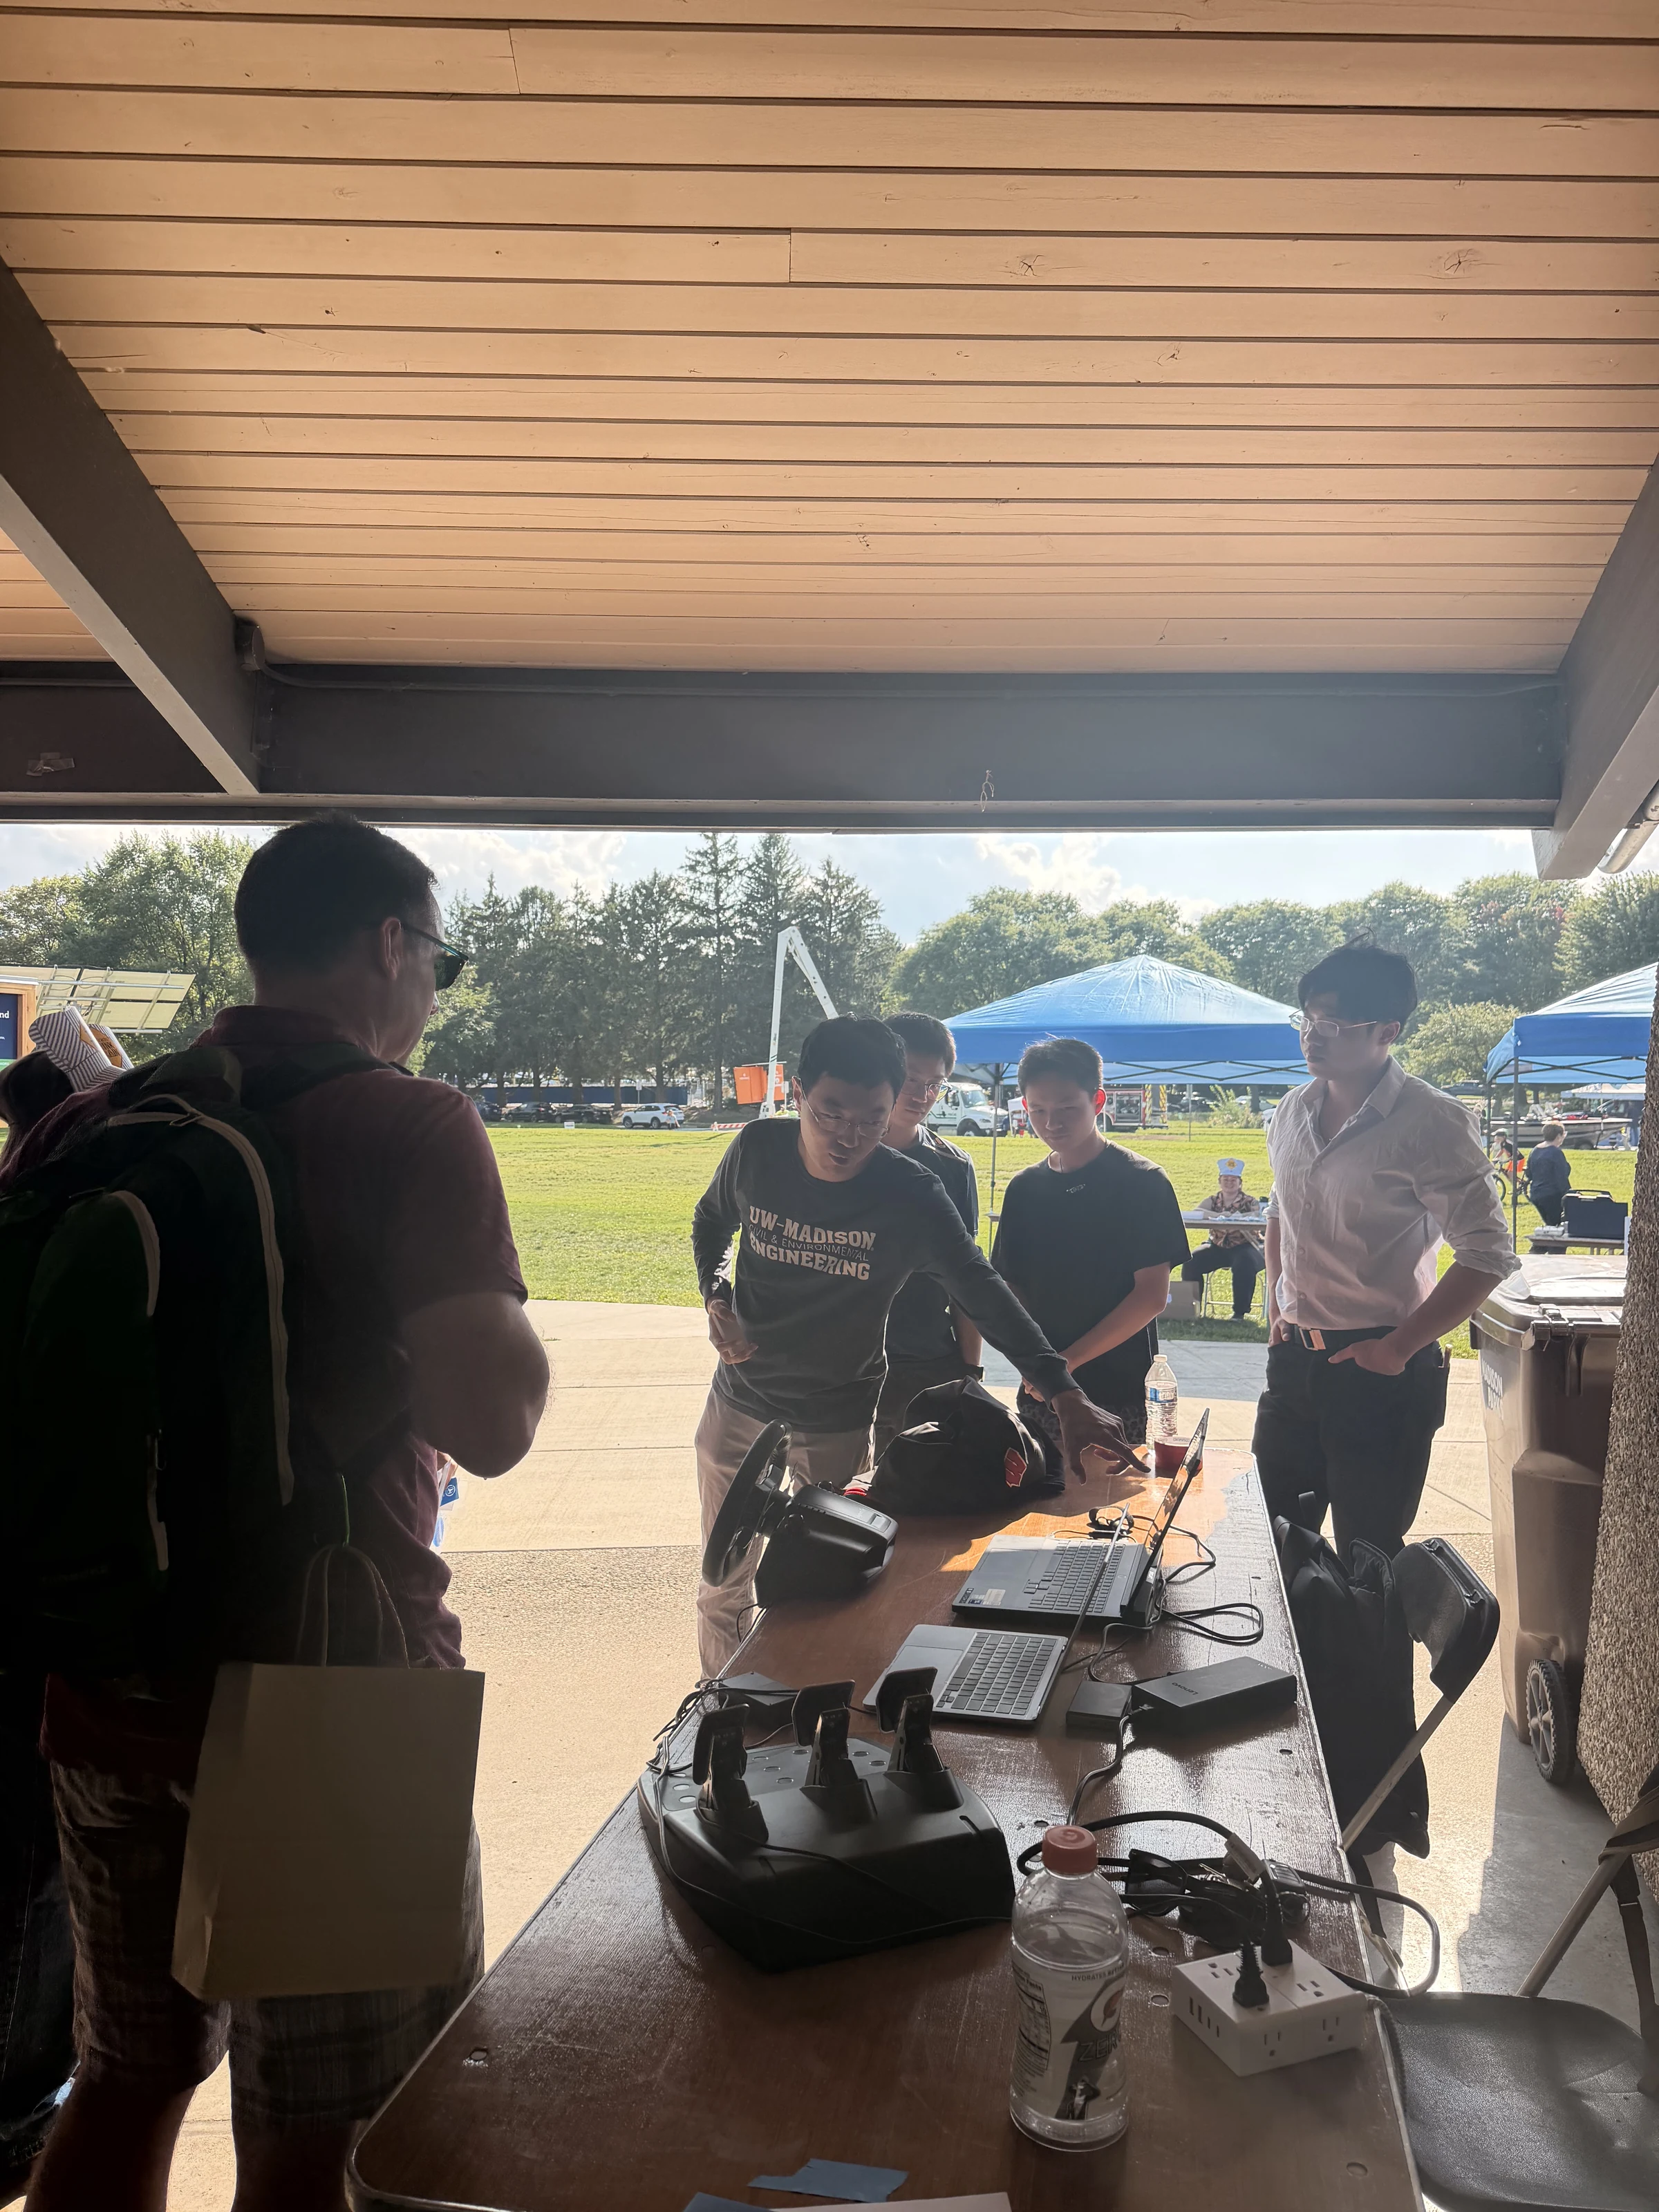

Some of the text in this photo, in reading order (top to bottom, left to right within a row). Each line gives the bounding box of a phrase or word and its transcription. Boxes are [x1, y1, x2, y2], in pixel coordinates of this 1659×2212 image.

[749, 1205, 877, 1250] UW-MADISON
[749, 1224, 869, 1262] CIVIL & ENVIRONMENTAL
[749, 1230, 870, 1281] ENGINEERING
[1071, 1971, 1107, 1983] HYDRATES
